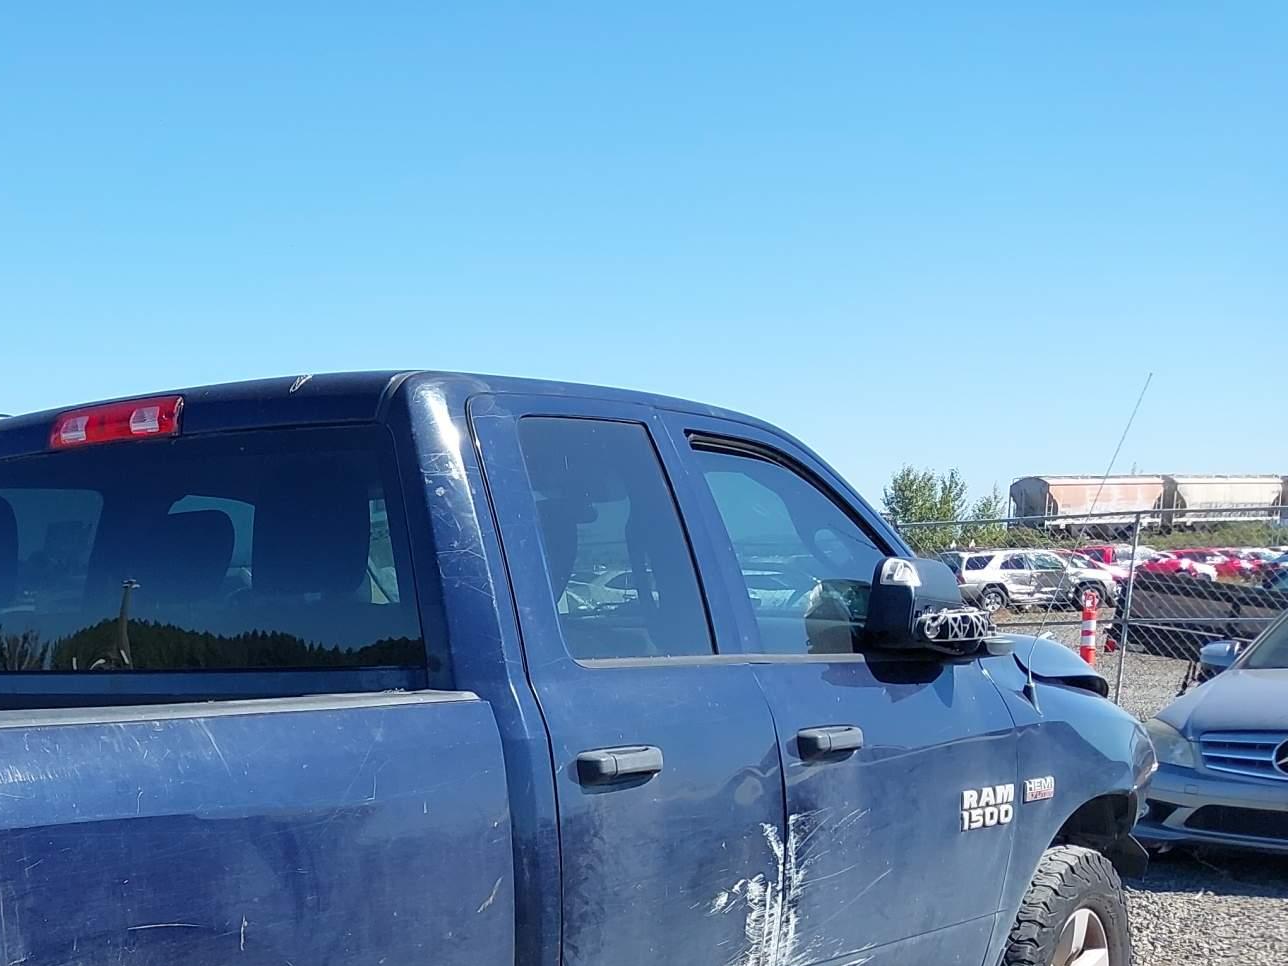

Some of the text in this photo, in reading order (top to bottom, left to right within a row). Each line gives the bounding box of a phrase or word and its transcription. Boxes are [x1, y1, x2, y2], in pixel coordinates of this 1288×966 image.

[961, 783, 1015, 810] RAM
[1024, 776, 1055, 793] HEMI
[961, 803, 1014, 831] 1500
